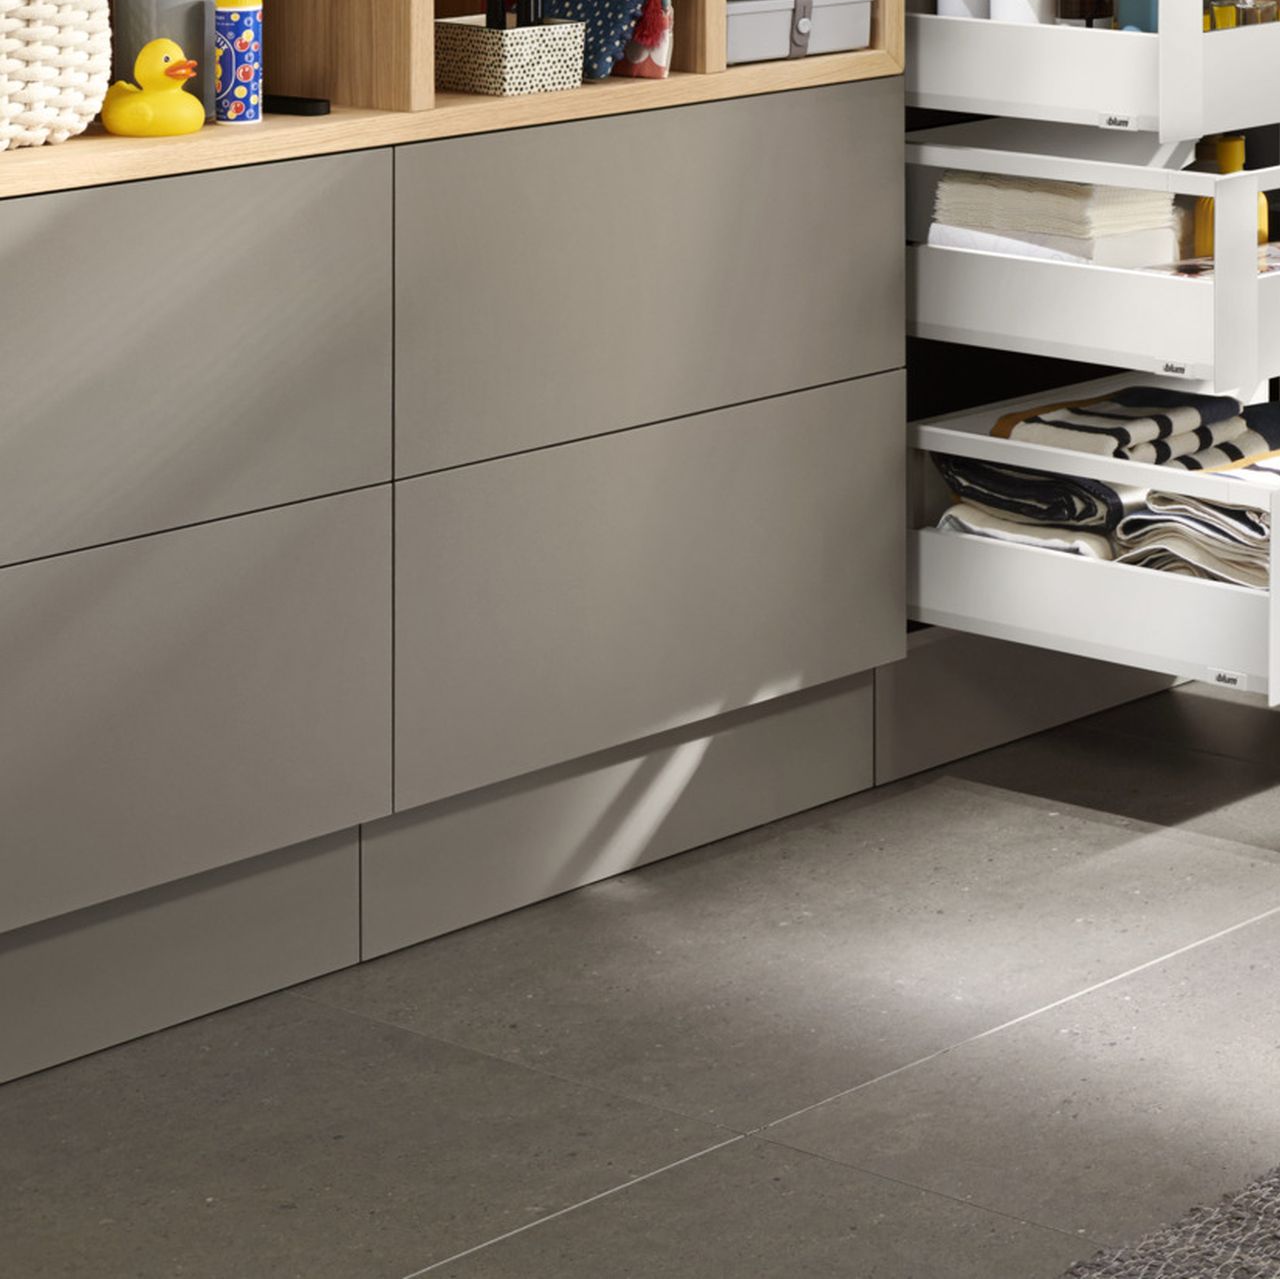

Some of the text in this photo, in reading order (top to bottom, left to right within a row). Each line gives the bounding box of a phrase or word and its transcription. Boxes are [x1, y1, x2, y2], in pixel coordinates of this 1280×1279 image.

[1106, 116, 1129, 127] blum
[1163, 363, 1185, 374] blum
[1216, 673, 1238, 686] blum
